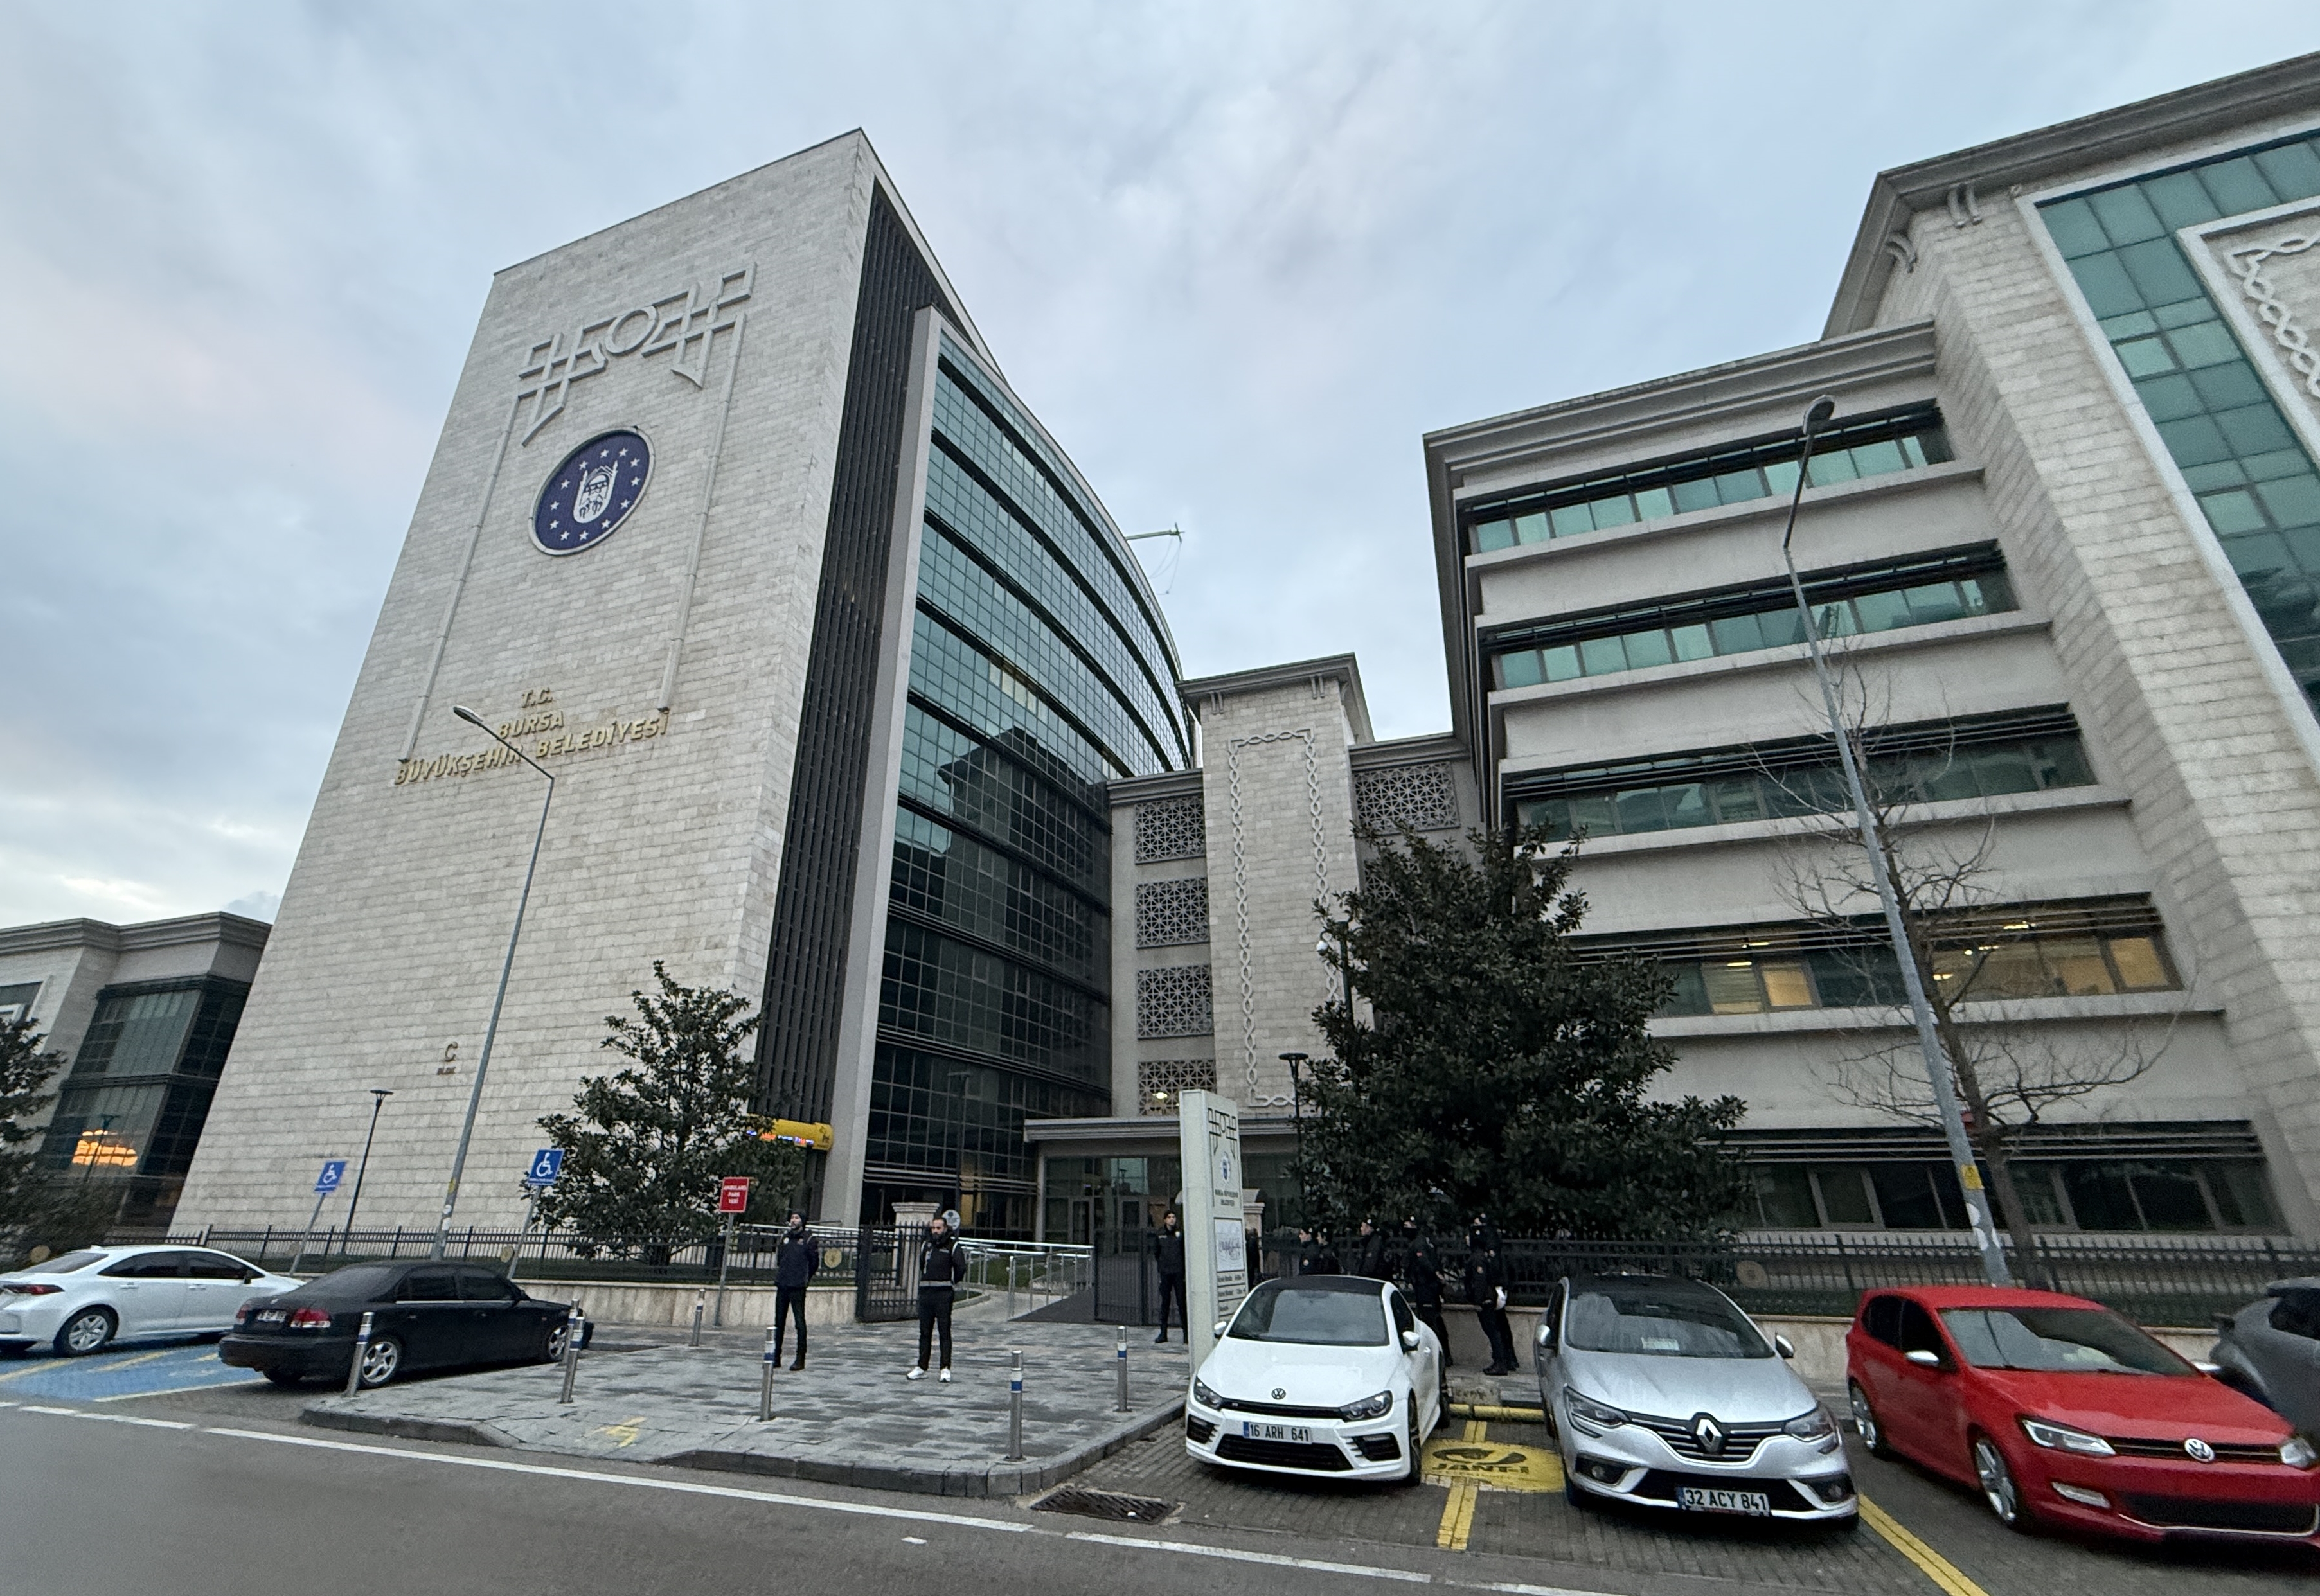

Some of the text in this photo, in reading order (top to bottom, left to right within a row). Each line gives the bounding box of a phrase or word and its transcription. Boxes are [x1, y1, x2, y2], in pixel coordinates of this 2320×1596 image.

[521, 687, 553, 708] T.C.
[497, 709, 565, 740] BURSA
[393, 710, 670, 785] BÜYÜKŞEHİR BELEDİYESİ
[444, 1040, 459, 1062] C
[1250, 1424, 1309, 1442] 16 ARH 641
[1685, 1489, 1767, 1511] 32 ACY 841
